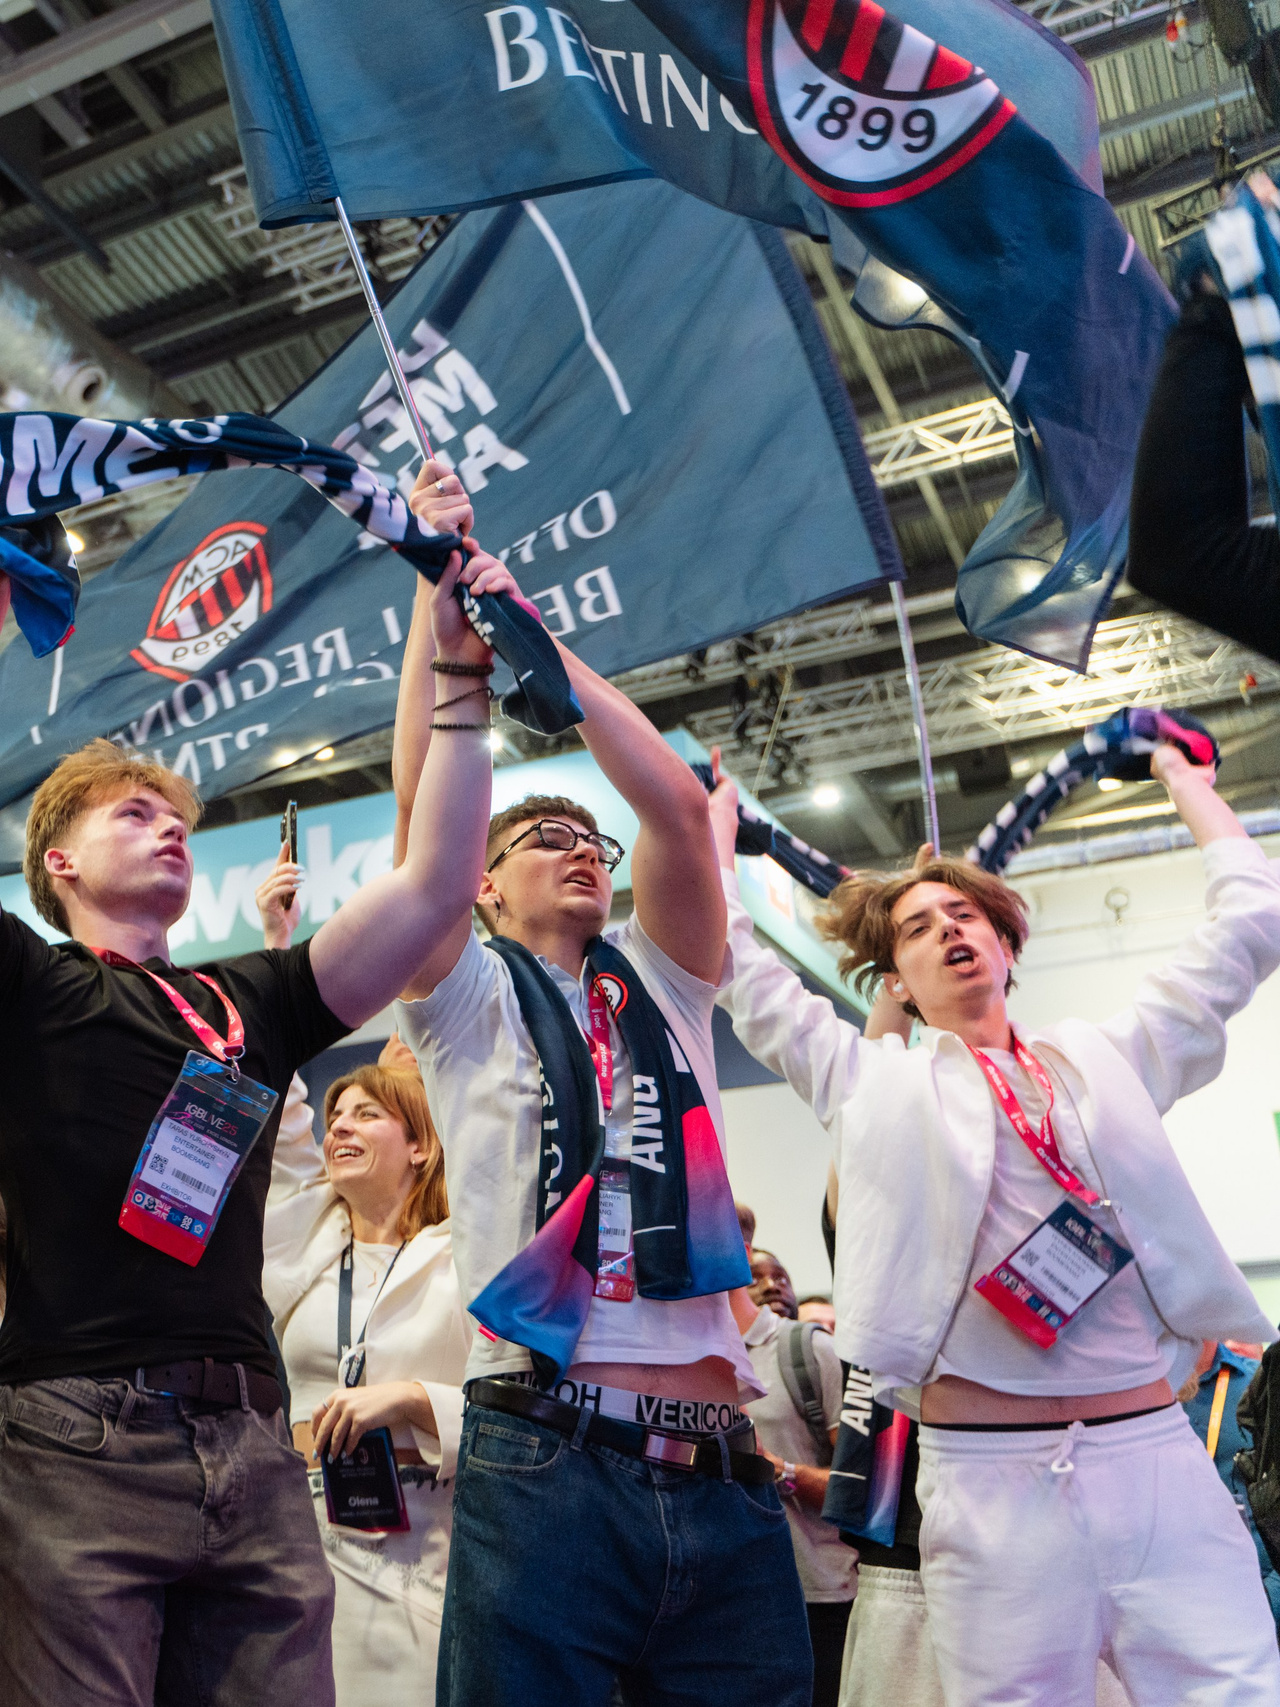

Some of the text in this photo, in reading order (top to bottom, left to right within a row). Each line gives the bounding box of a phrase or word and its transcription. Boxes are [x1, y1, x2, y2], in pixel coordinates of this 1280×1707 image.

[794, 83, 936, 153] 1899
[167, 1121, 189, 1136] TARAS
[170, 1144, 211, 1169] BOOMERANG
[172, 1135, 216, 1161] ENTERTAINER
[160, 1181, 192, 1202] EXHIBITOR
[636, 1394, 740, 1431] VERICOH
